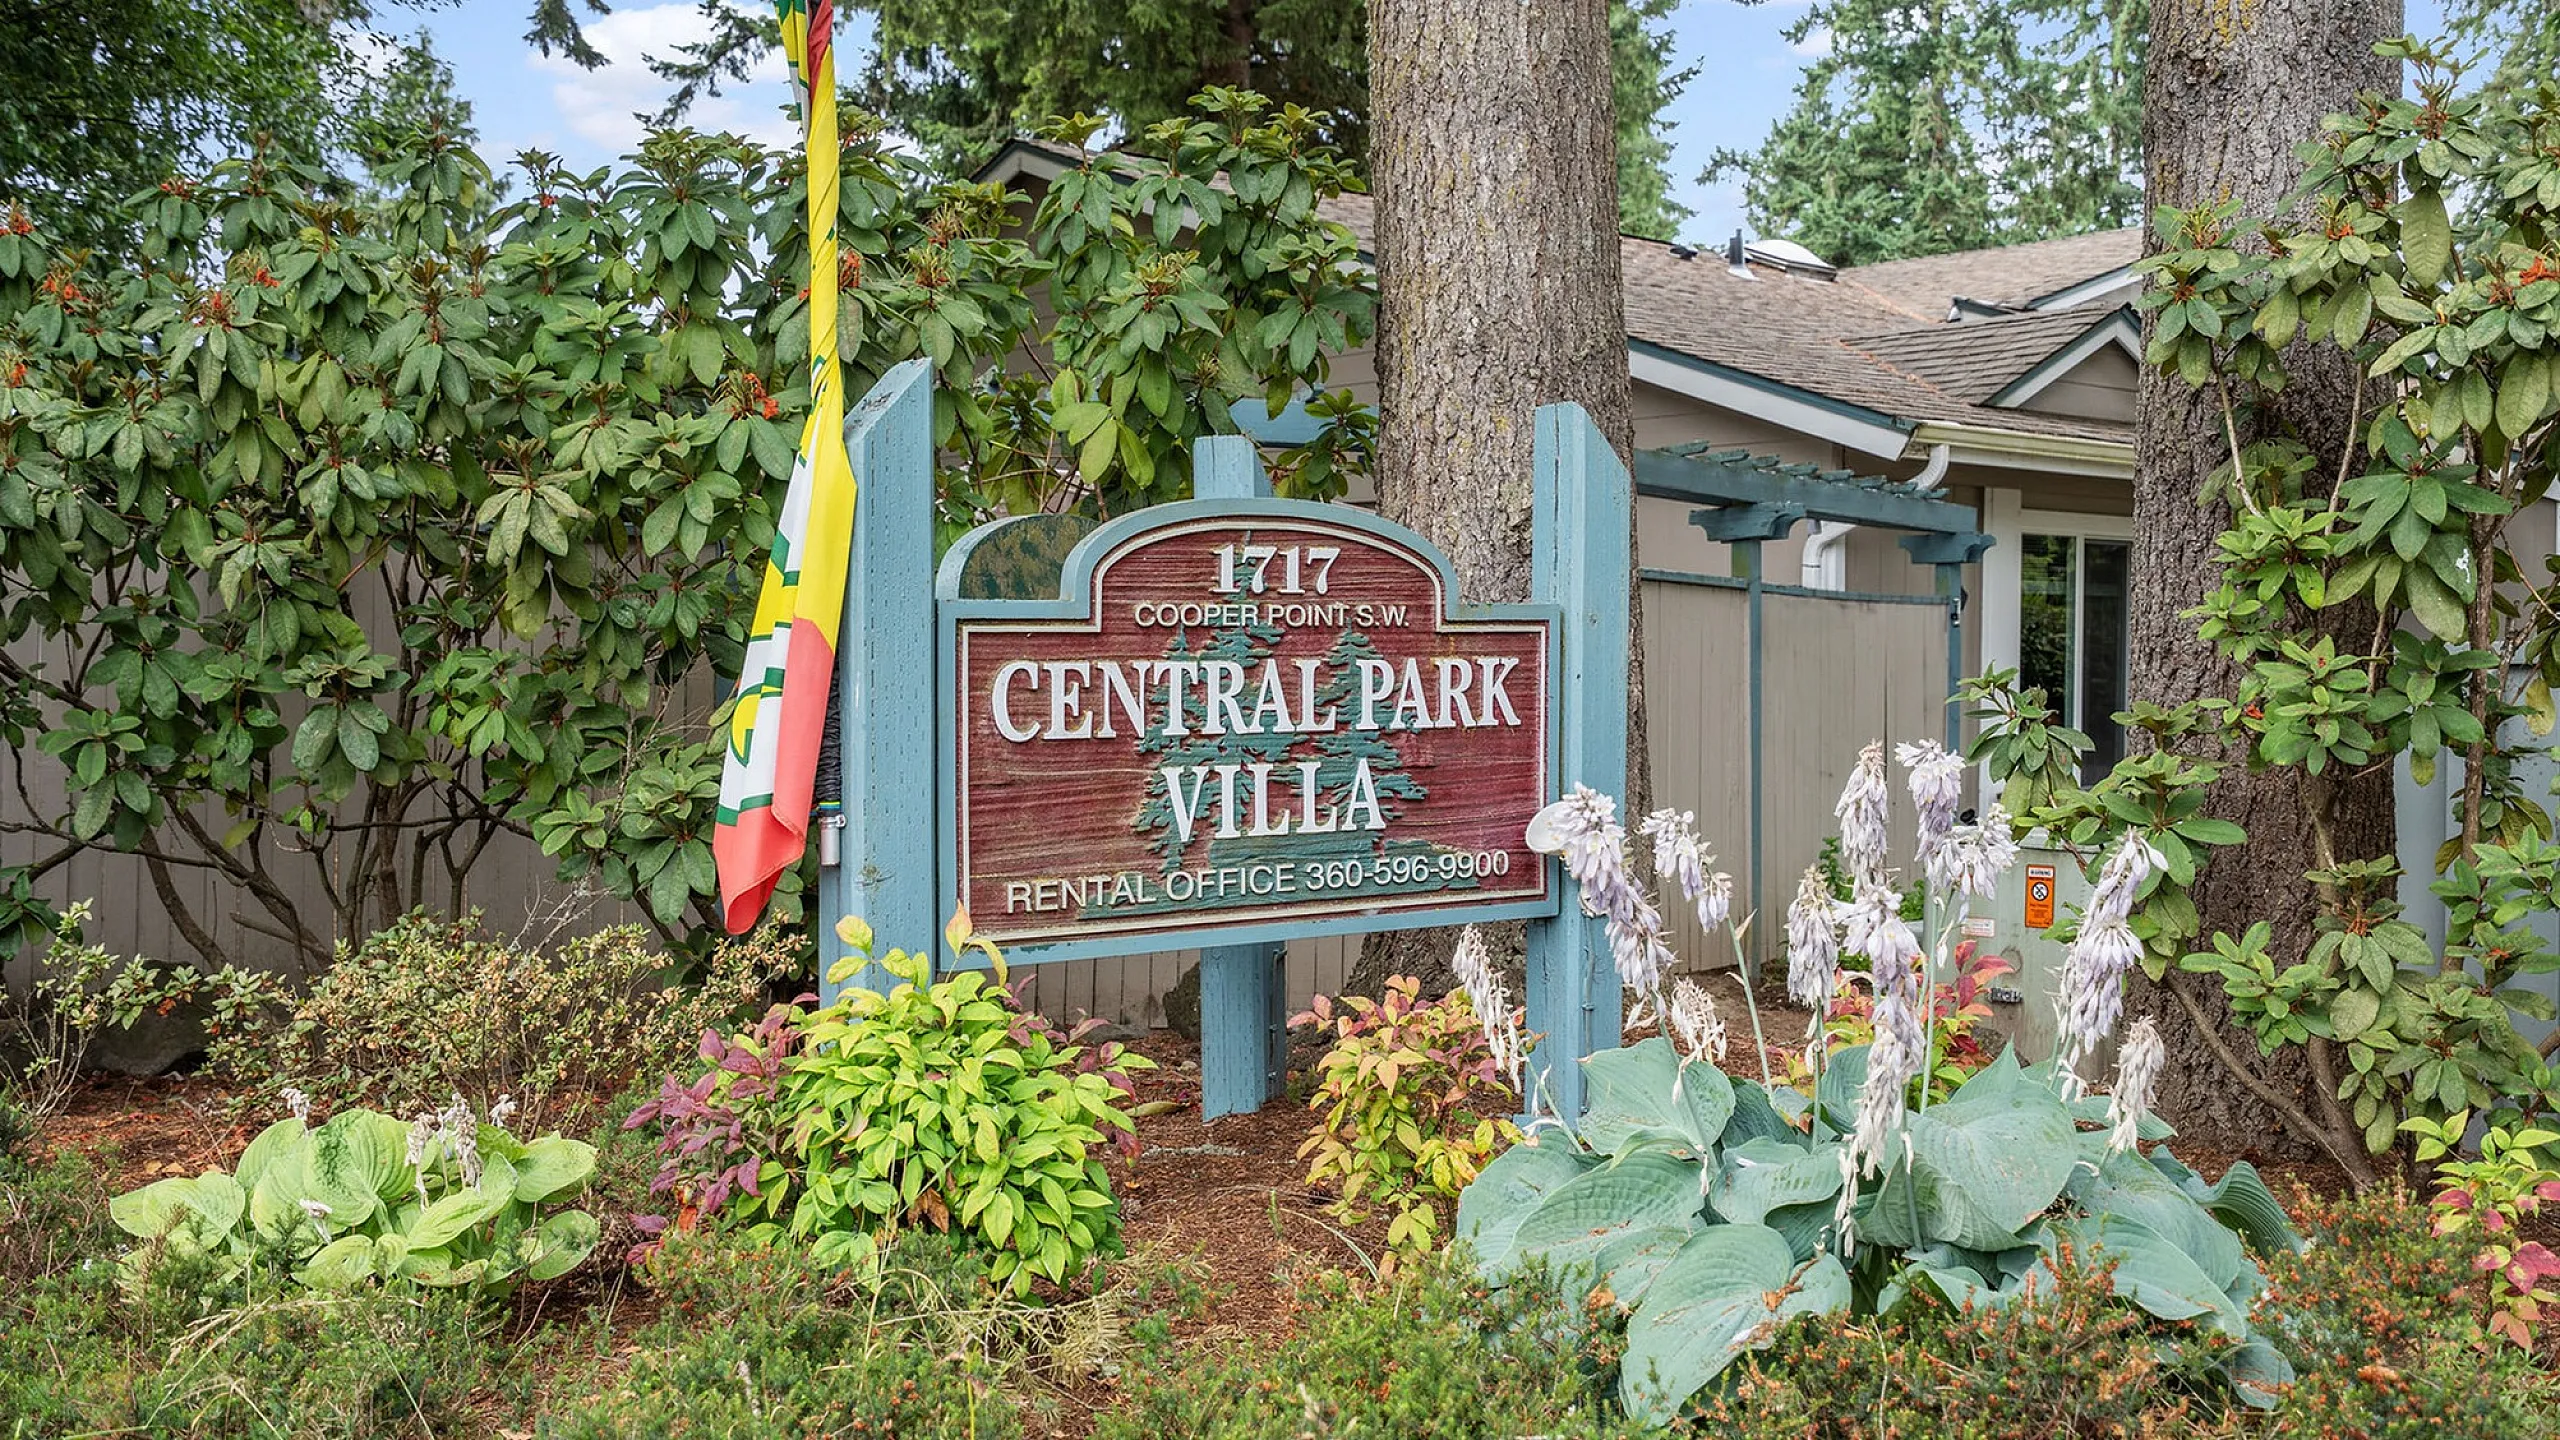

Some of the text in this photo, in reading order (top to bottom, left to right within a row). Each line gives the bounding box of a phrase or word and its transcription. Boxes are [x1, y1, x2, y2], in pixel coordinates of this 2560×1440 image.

[1210, 543, 1341, 595] 1717
[1134, 603, 1409, 628] COOPER POINT S.W.
[991, 656, 1522, 743] CENTRAL PARK
[1161, 757, 1387, 842] VILLA
[1006, 849, 1510, 914] RENTAL OFFICE 360-596-9900
